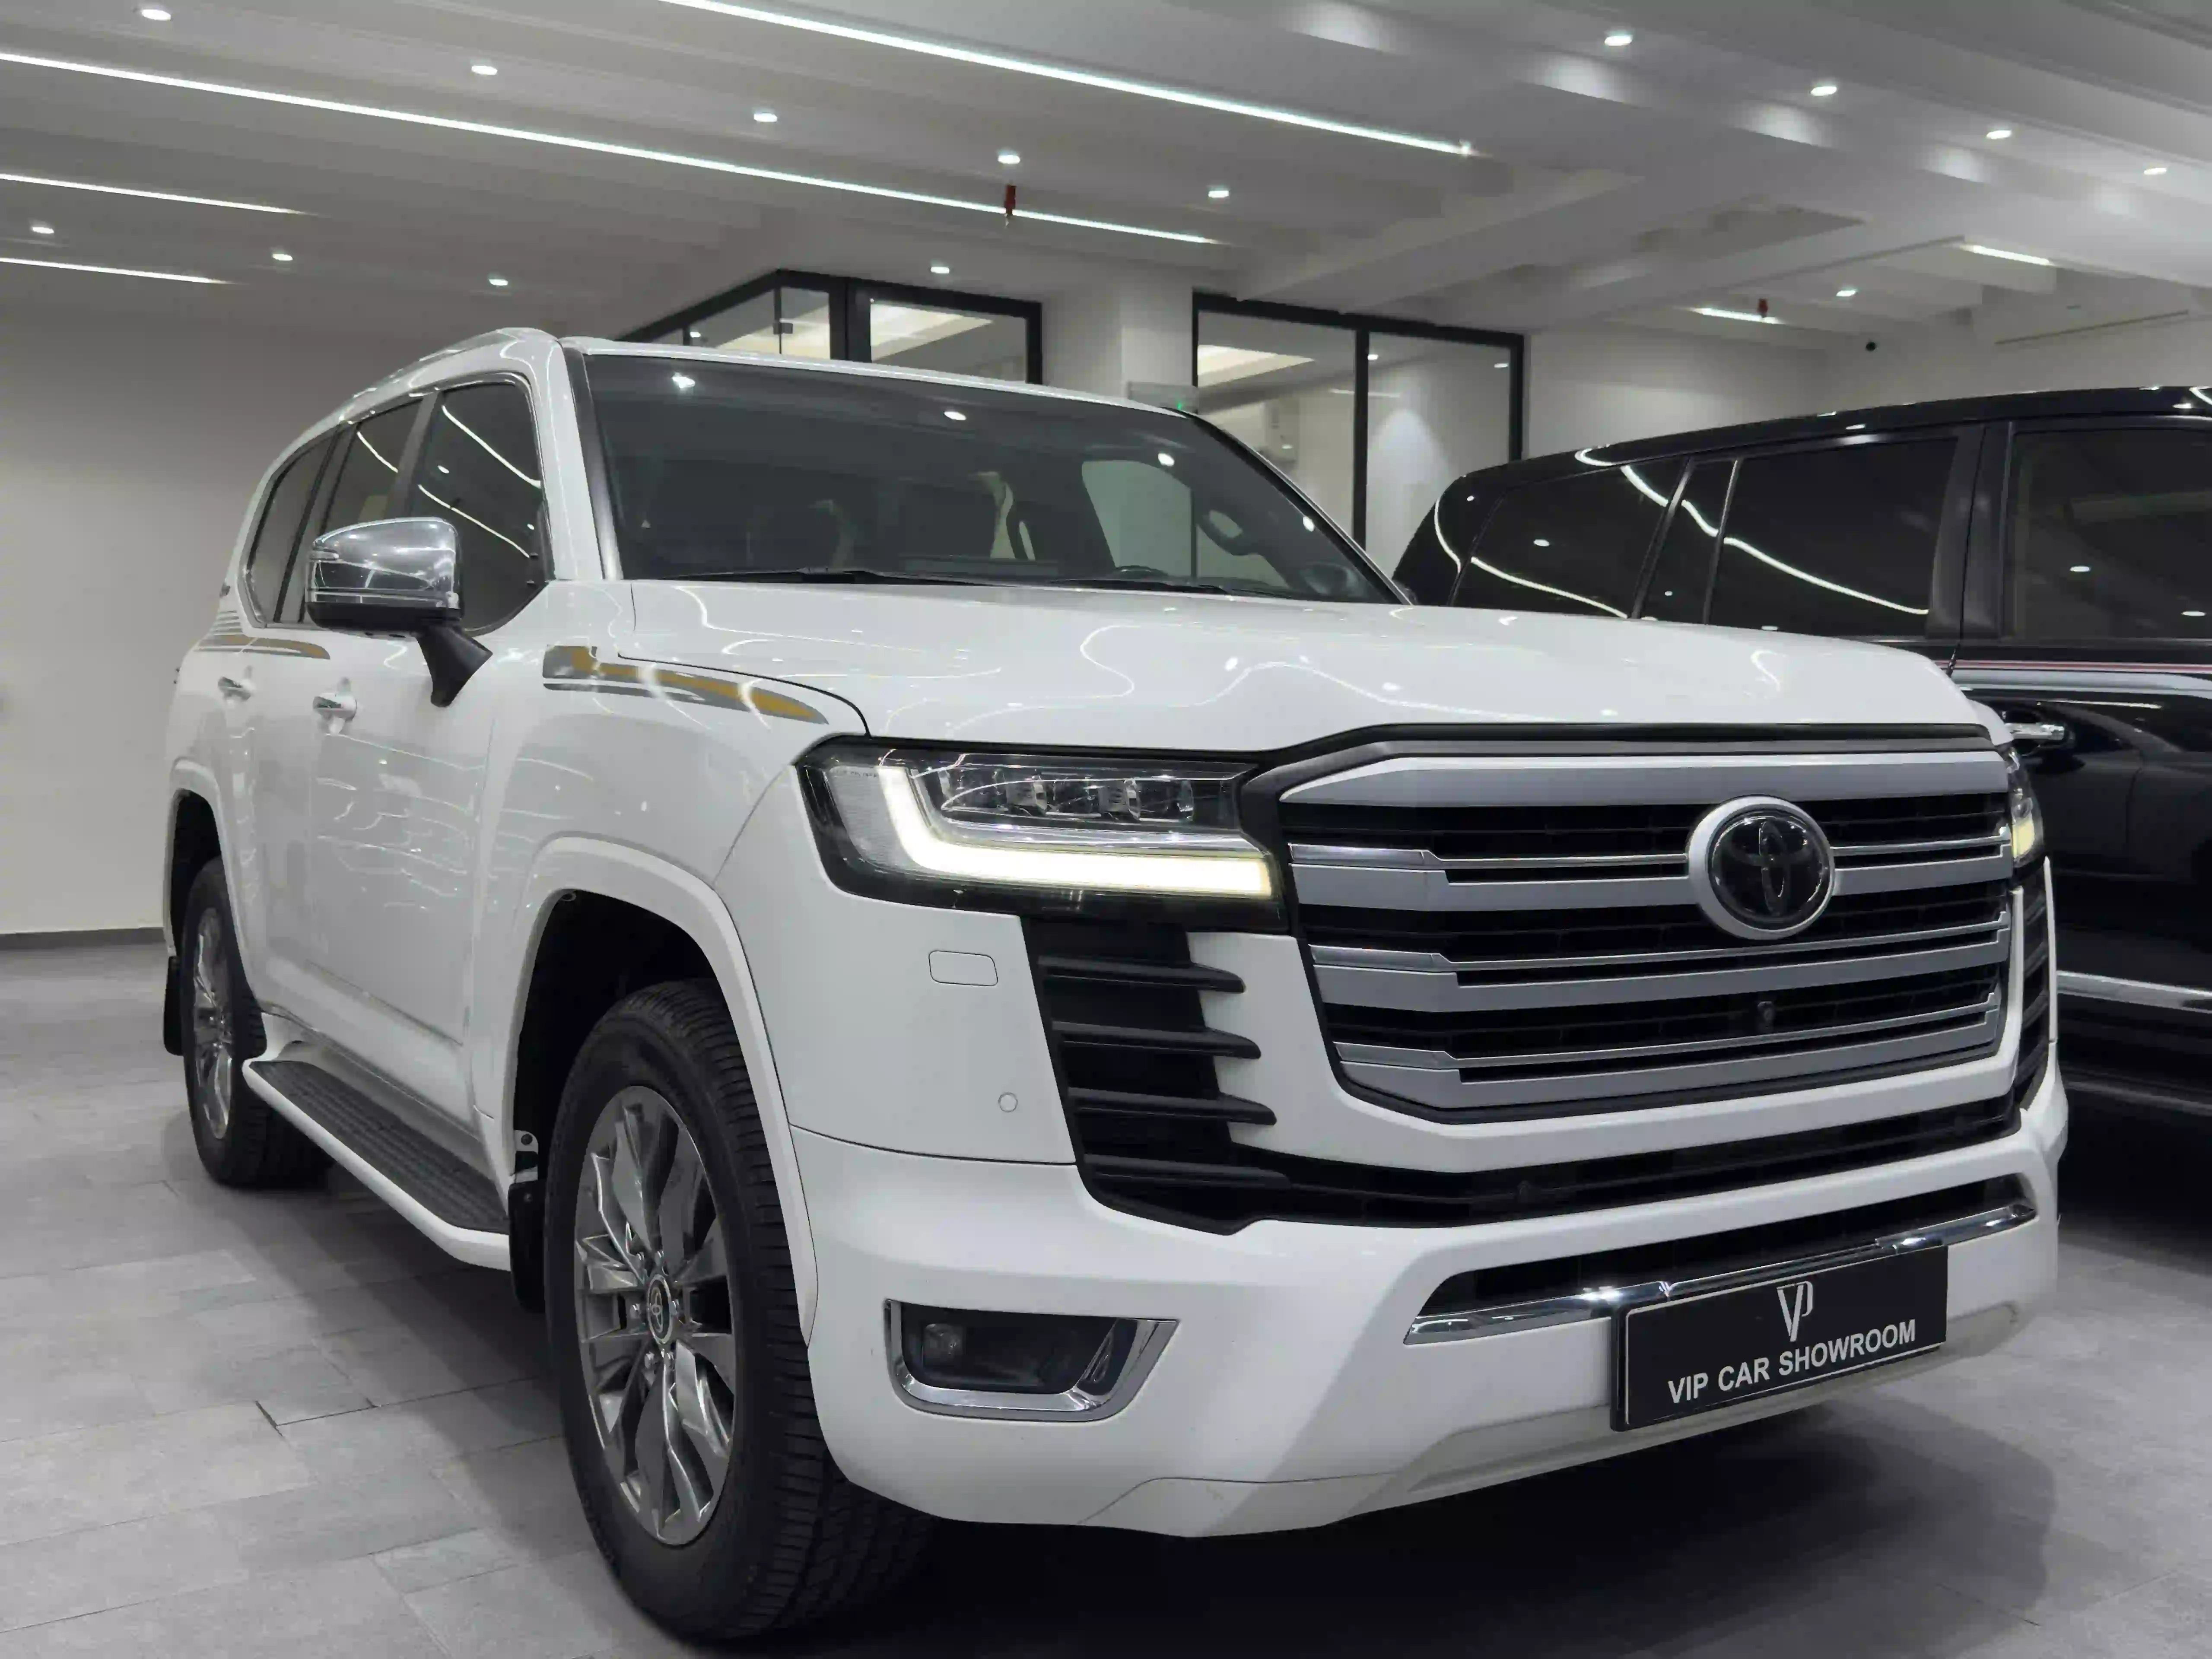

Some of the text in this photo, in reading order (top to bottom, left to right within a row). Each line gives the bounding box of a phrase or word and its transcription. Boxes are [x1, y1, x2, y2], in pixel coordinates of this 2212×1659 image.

[1667, 1319, 1916, 1404] VIP CAR SHOWROOM
